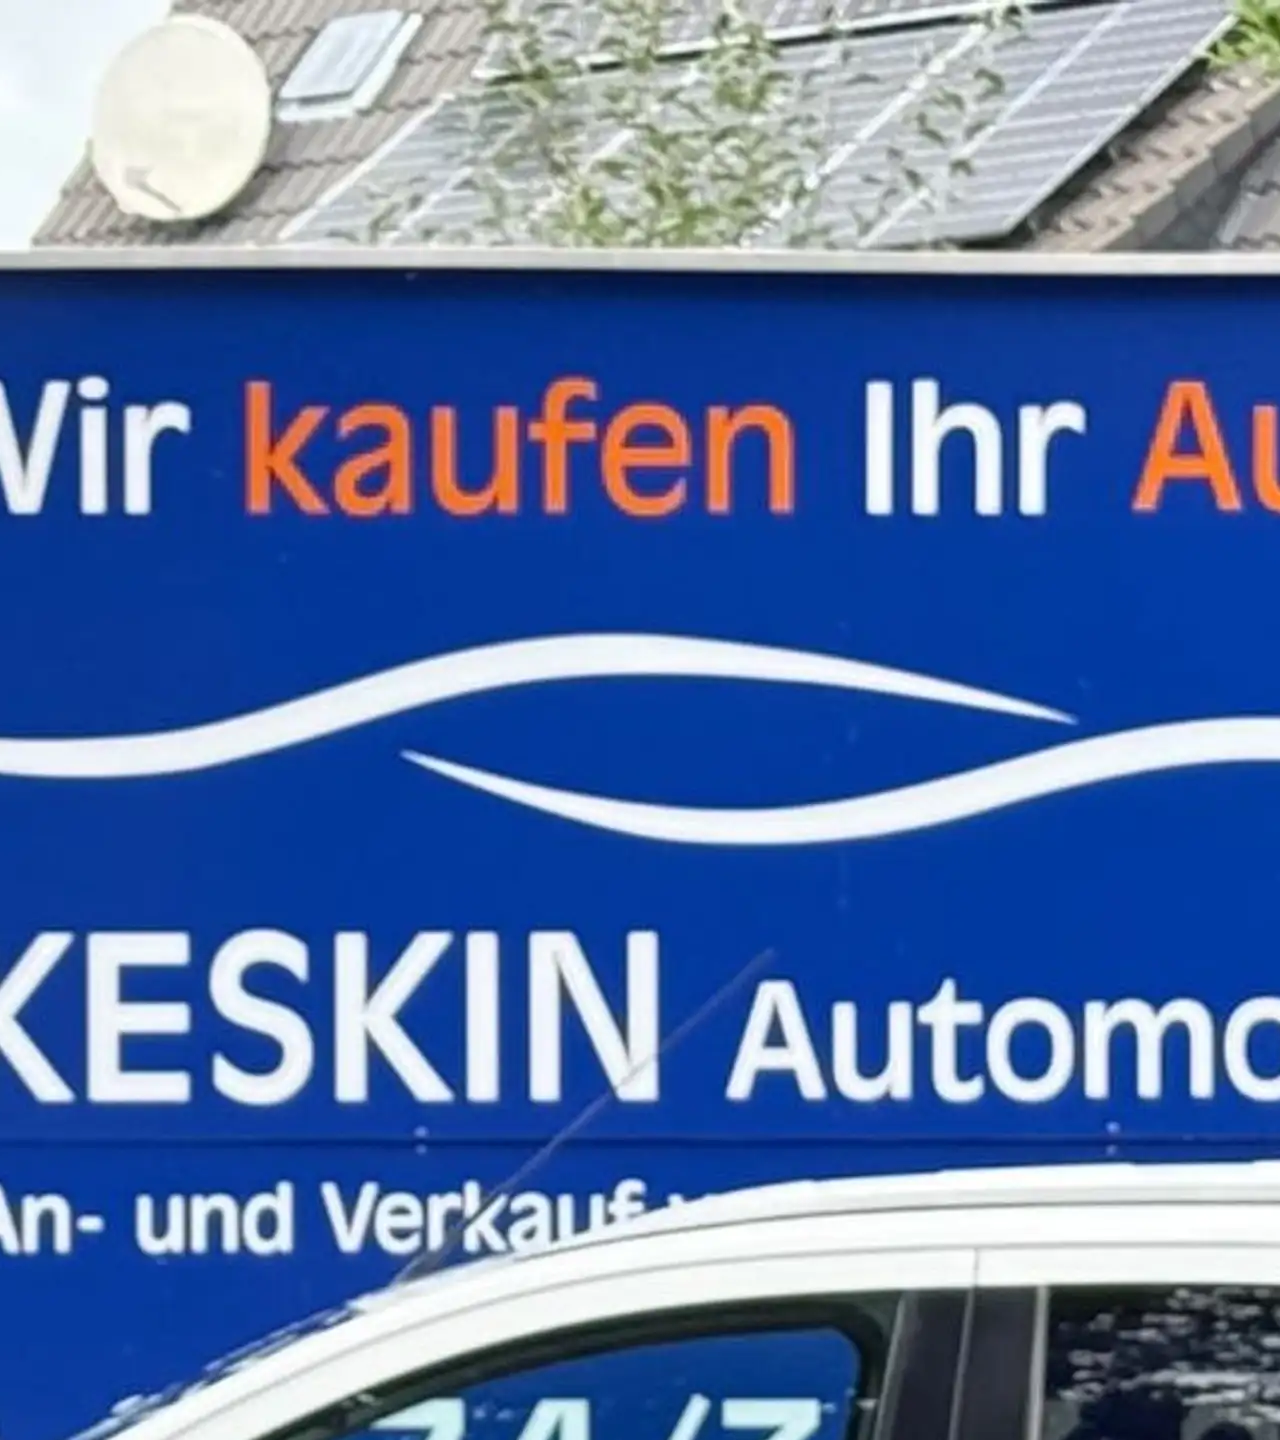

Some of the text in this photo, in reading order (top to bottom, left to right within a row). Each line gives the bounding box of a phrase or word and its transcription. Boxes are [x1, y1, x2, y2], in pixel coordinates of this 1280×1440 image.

[244, 377, 794, 517] kaufen
[866, 378, 1086, 517] Ihr
[135, 1181, 293, 1255] und
[322, 1178, 648, 1255] Verkauf
